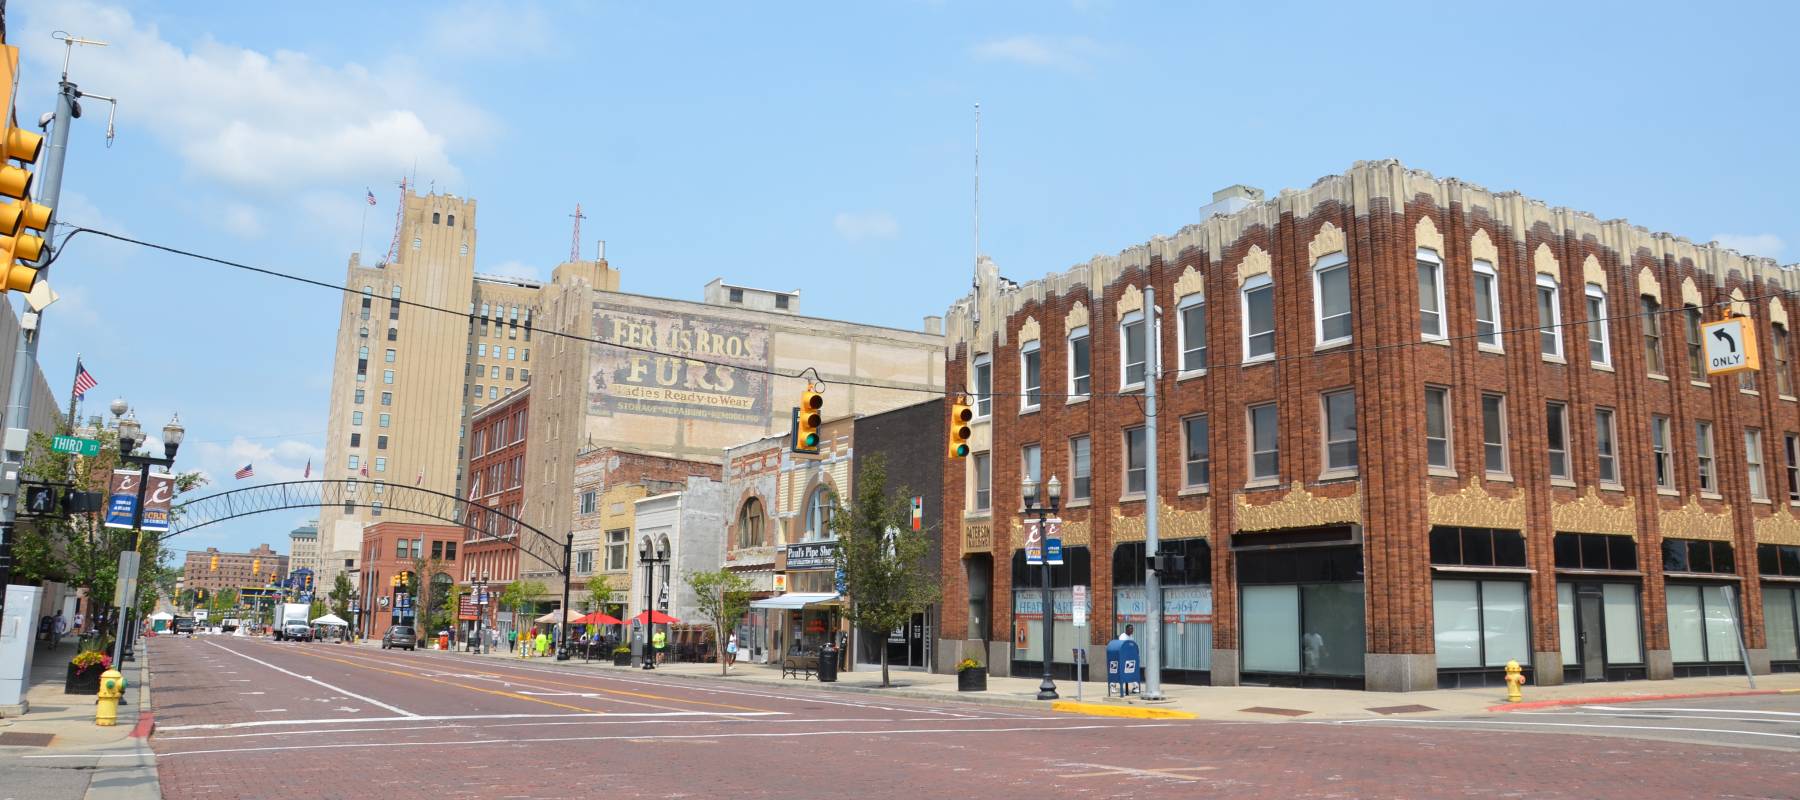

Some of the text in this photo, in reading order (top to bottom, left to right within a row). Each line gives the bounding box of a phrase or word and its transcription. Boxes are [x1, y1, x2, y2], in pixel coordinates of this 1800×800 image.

[612, 319, 692, 353] FERIS
[1713, 354, 1740, 367] ONLY
[626, 355, 735, 392] FURS
[54, 437, 83, 451] THIRD
[788, 545, 834, 559] Paul's Pipe Sho
